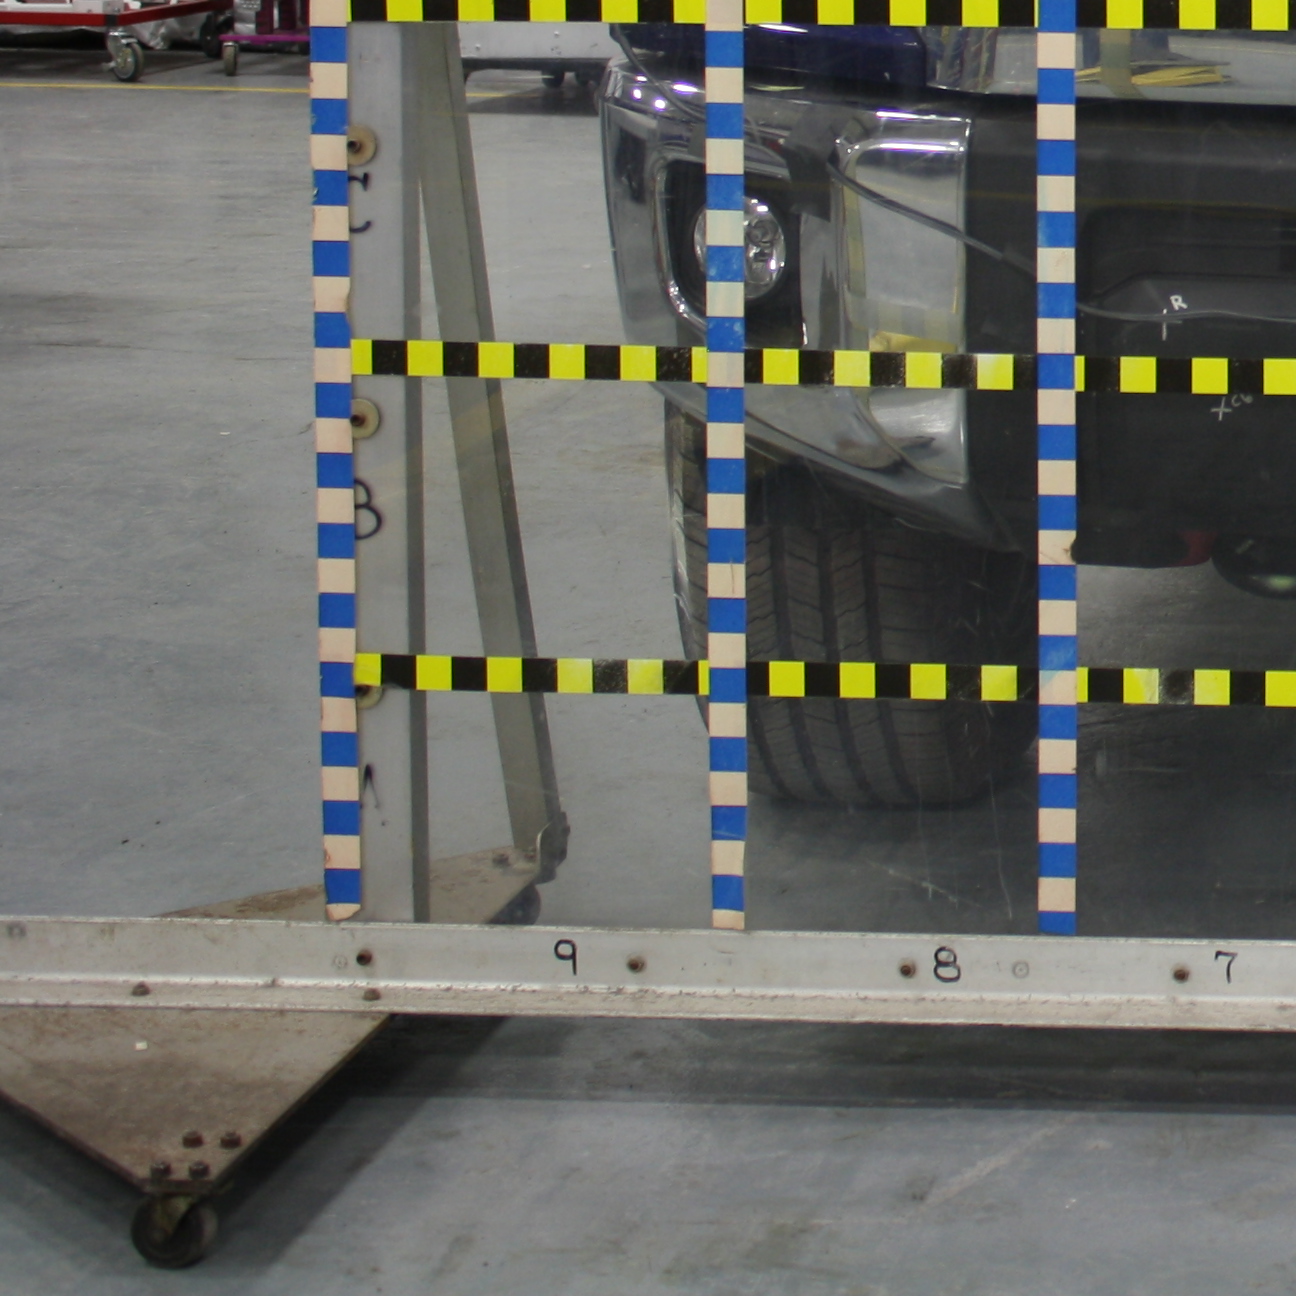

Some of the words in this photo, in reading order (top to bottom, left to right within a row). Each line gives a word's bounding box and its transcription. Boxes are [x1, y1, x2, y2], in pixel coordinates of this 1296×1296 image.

[1169, 294, 1188, 311] R
[553, 939, 578, 976] 9
[933, 946, 962, 984] 8
[1213, 950, 1239, 985] 7
